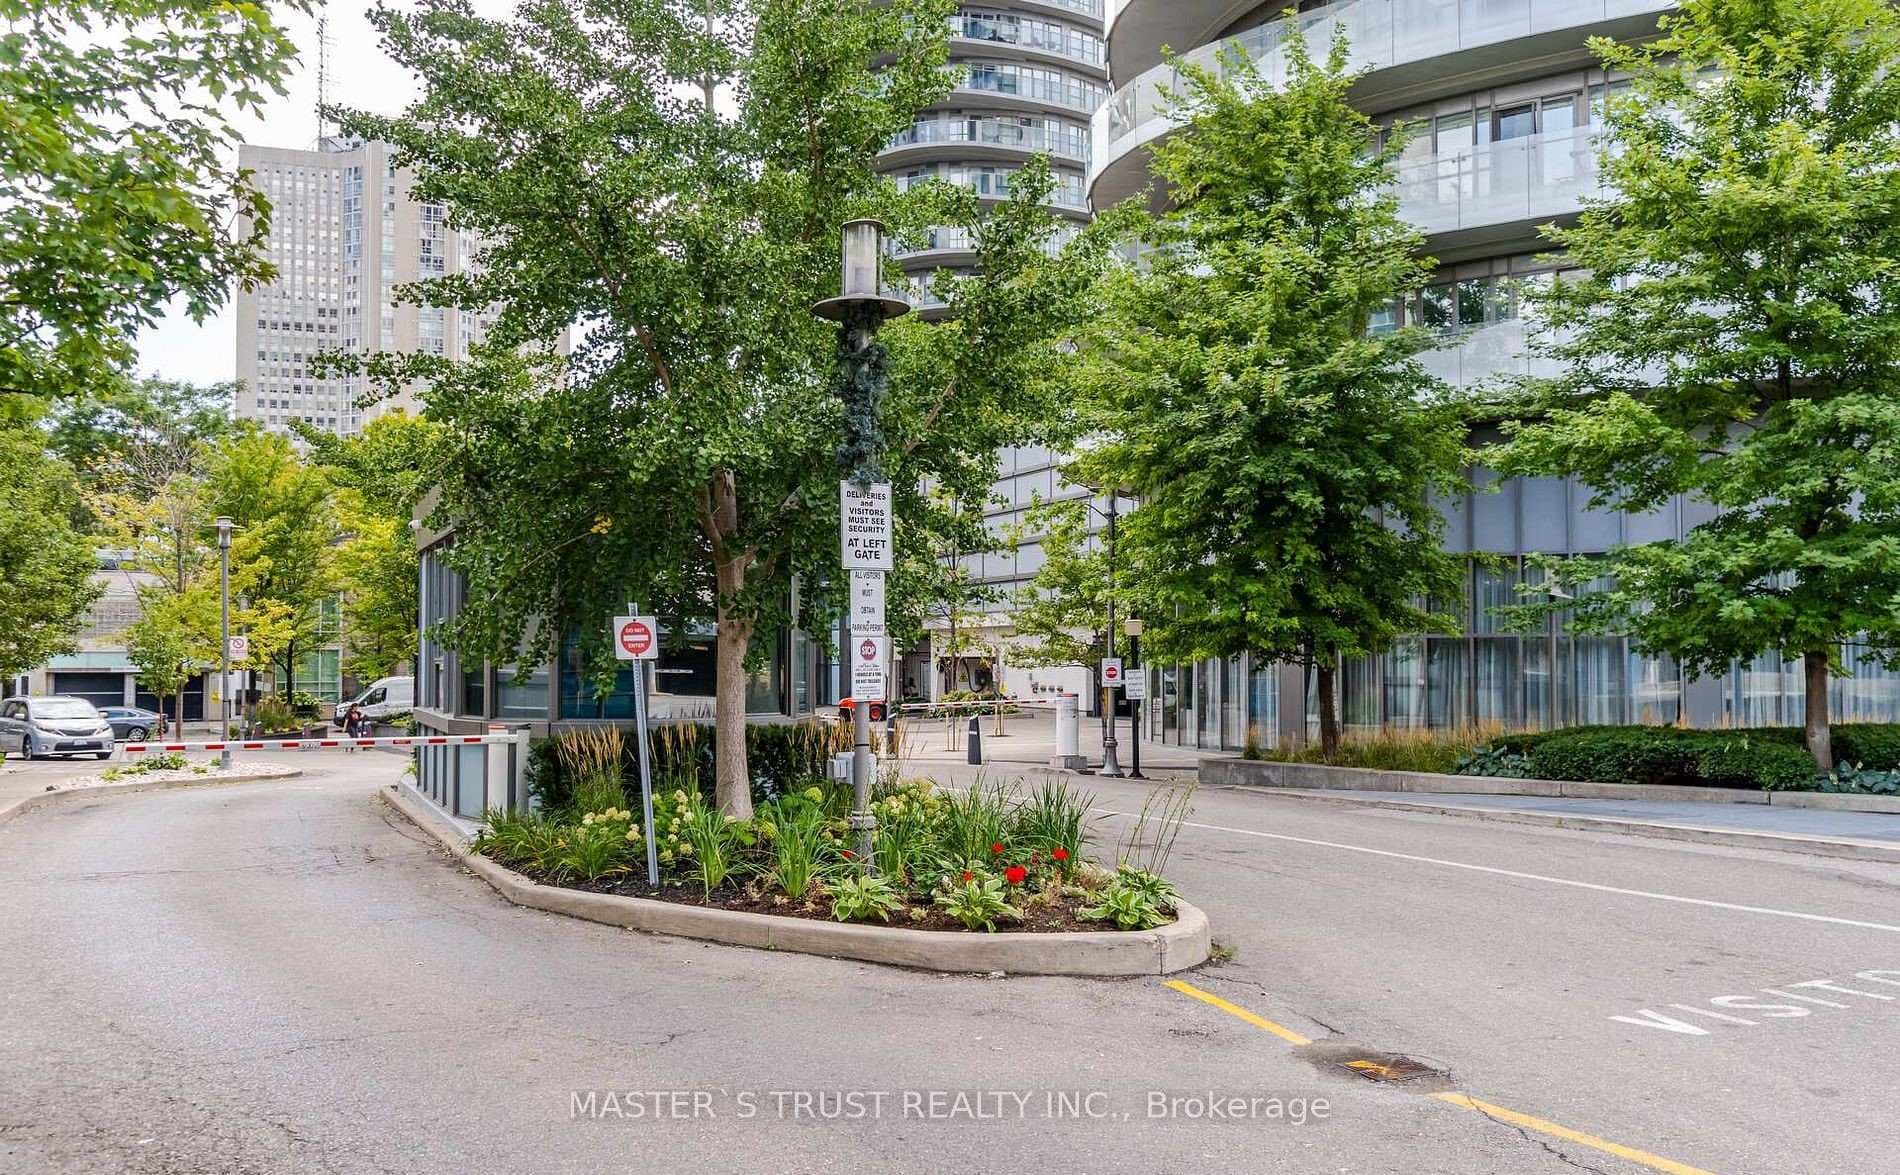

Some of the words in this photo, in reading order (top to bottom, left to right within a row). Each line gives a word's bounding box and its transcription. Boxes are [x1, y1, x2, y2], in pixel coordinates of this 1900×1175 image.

[846, 490, 887, 500] DELIVERIES
[849, 507, 885, 517] VISITORS
[848, 516, 869, 525] MUST
[871, 517, 885, 525] SEE
[848, 525, 885, 534] SECURITY
[848, 538, 859, 547] AT
[863, 539, 886, 549] LEFT
[854, 550, 880, 560] GATE
[862, 646, 875, 656] STOP
